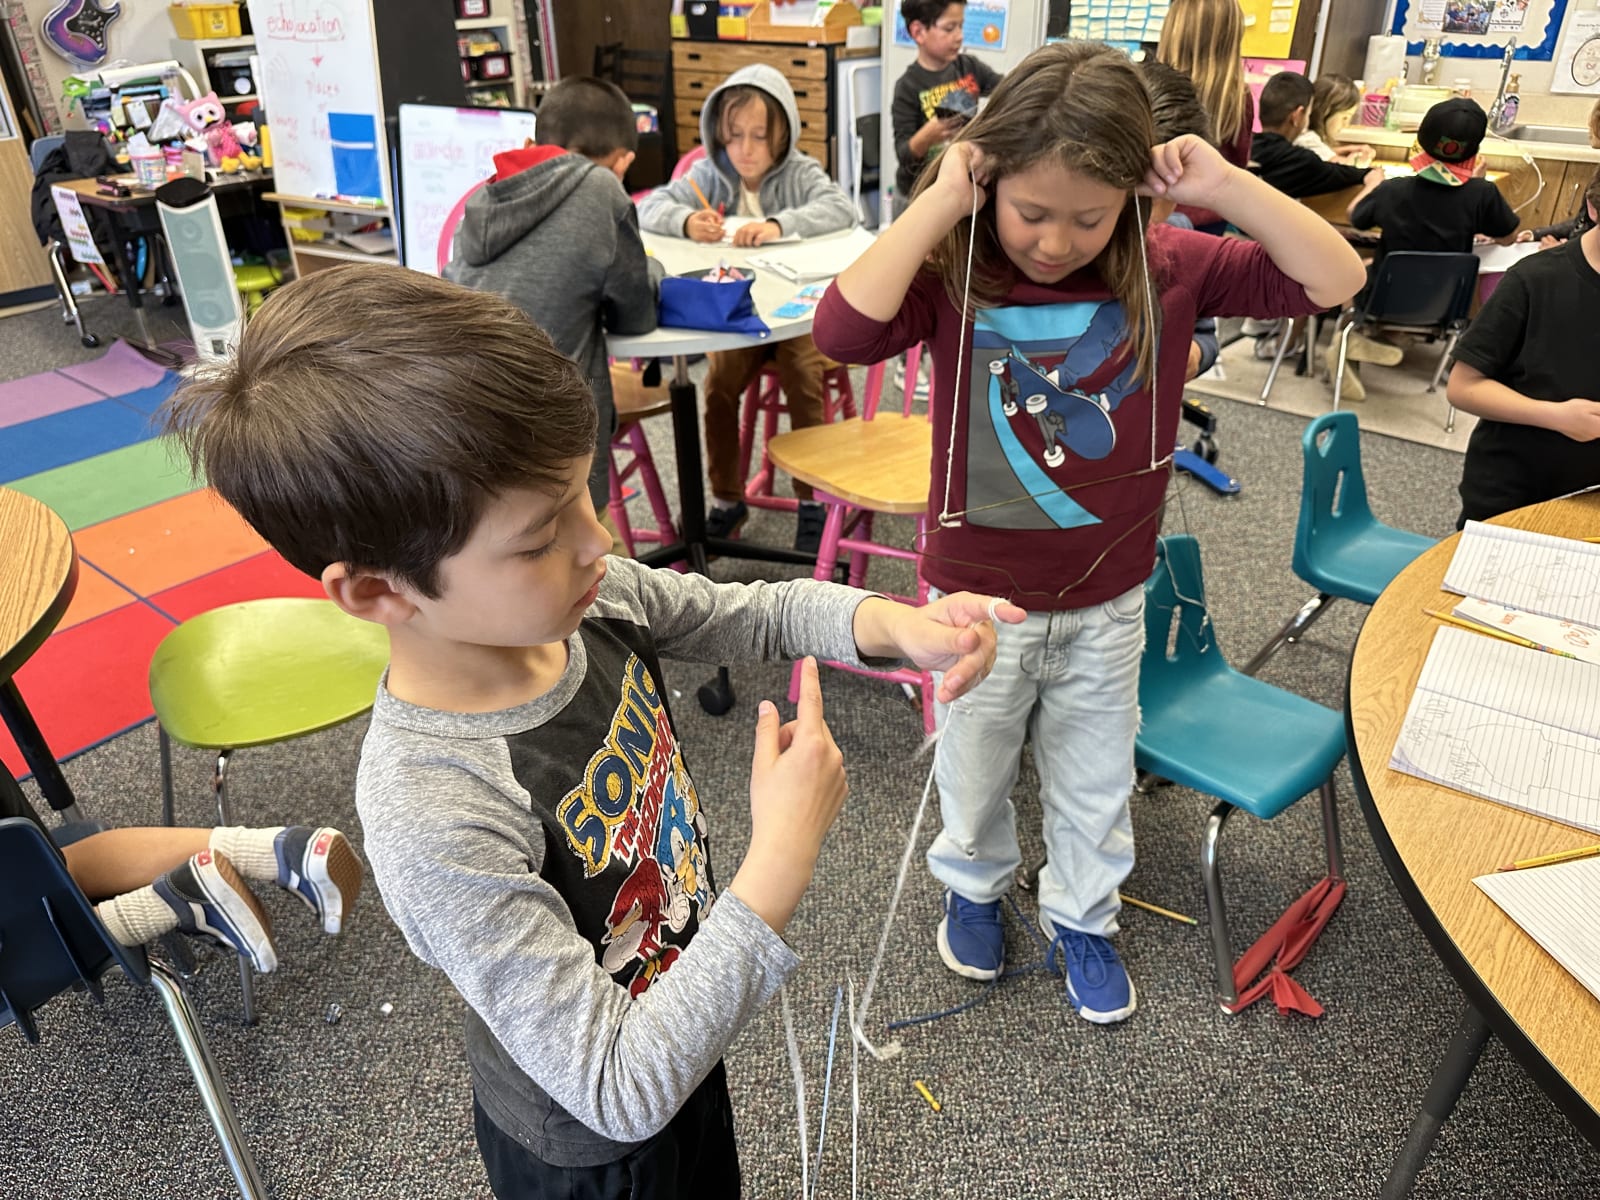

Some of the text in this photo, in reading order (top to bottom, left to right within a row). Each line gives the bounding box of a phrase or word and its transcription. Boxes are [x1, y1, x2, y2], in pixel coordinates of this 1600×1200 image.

[561, 655, 661, 868] SONIC
[612, 804, 642, 860] THE
[637, 710, 673, 860] HEDGEHO
